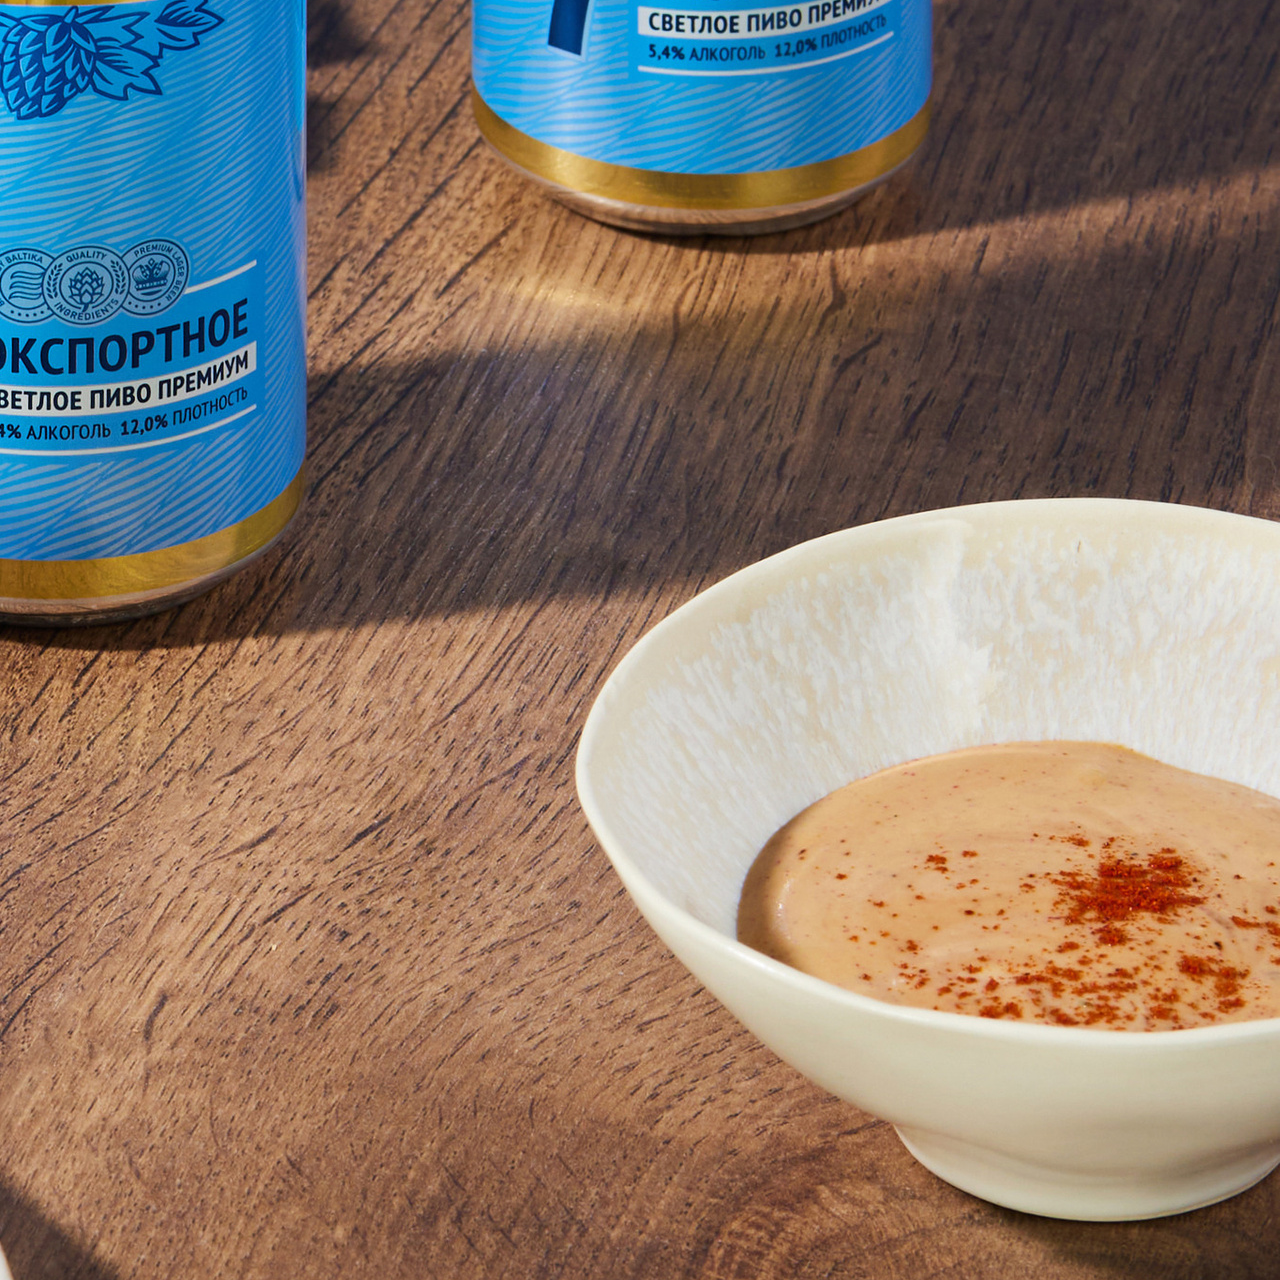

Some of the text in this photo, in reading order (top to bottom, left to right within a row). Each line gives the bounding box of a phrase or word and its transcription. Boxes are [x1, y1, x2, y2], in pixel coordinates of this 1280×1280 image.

[648, 13, 887, 61] 5,4% АЛКОГОЛЬ 12,0% ПЛОТНОСТЬ
[649, 11, 740, 34] СВЕТЛОЕ
[747, 8, 802, 32] ПИВО
[5, 252, 43, 265] BALTIKA
[66, 249, 107, 263] QUALITY
[134, 243, 185, 302] PREMIUM LAGER BEER
[54, 298, 119, 321] INGREDIENTS
[89, 383, 151, 410] ПИВО
[158, 351, 249, 400] ПРЕМИУМ
[26, 422, 111, 441] АЛКОГОЛЬ
[120, 413, 169, 437] 12,0%
[172, 386, 248, 427] ПЛОТНОСТЬ
